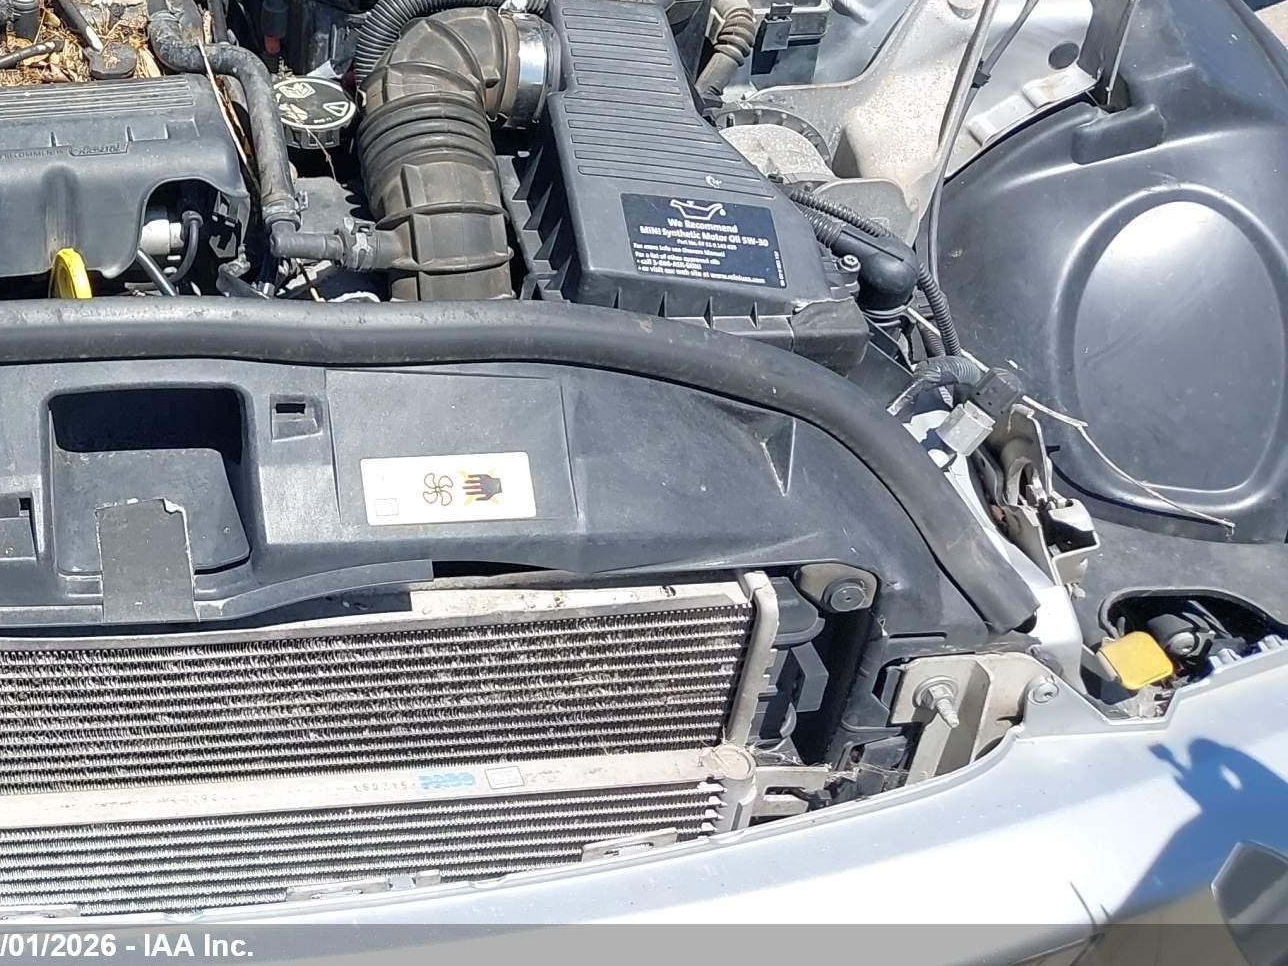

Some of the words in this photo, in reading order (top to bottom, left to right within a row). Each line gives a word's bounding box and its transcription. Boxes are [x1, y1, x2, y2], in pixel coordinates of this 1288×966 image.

[667, 217, 683, 227] We
[684, 219, 739, 234] Recommend
[639, 225, 662, 235] MINI
[662, 227, 702, 238] Synthetic
[702, 231, 728, 243] Motor
[728, 234, 742, 244] Oil
[741, 235, 769, 247] 5W-30
